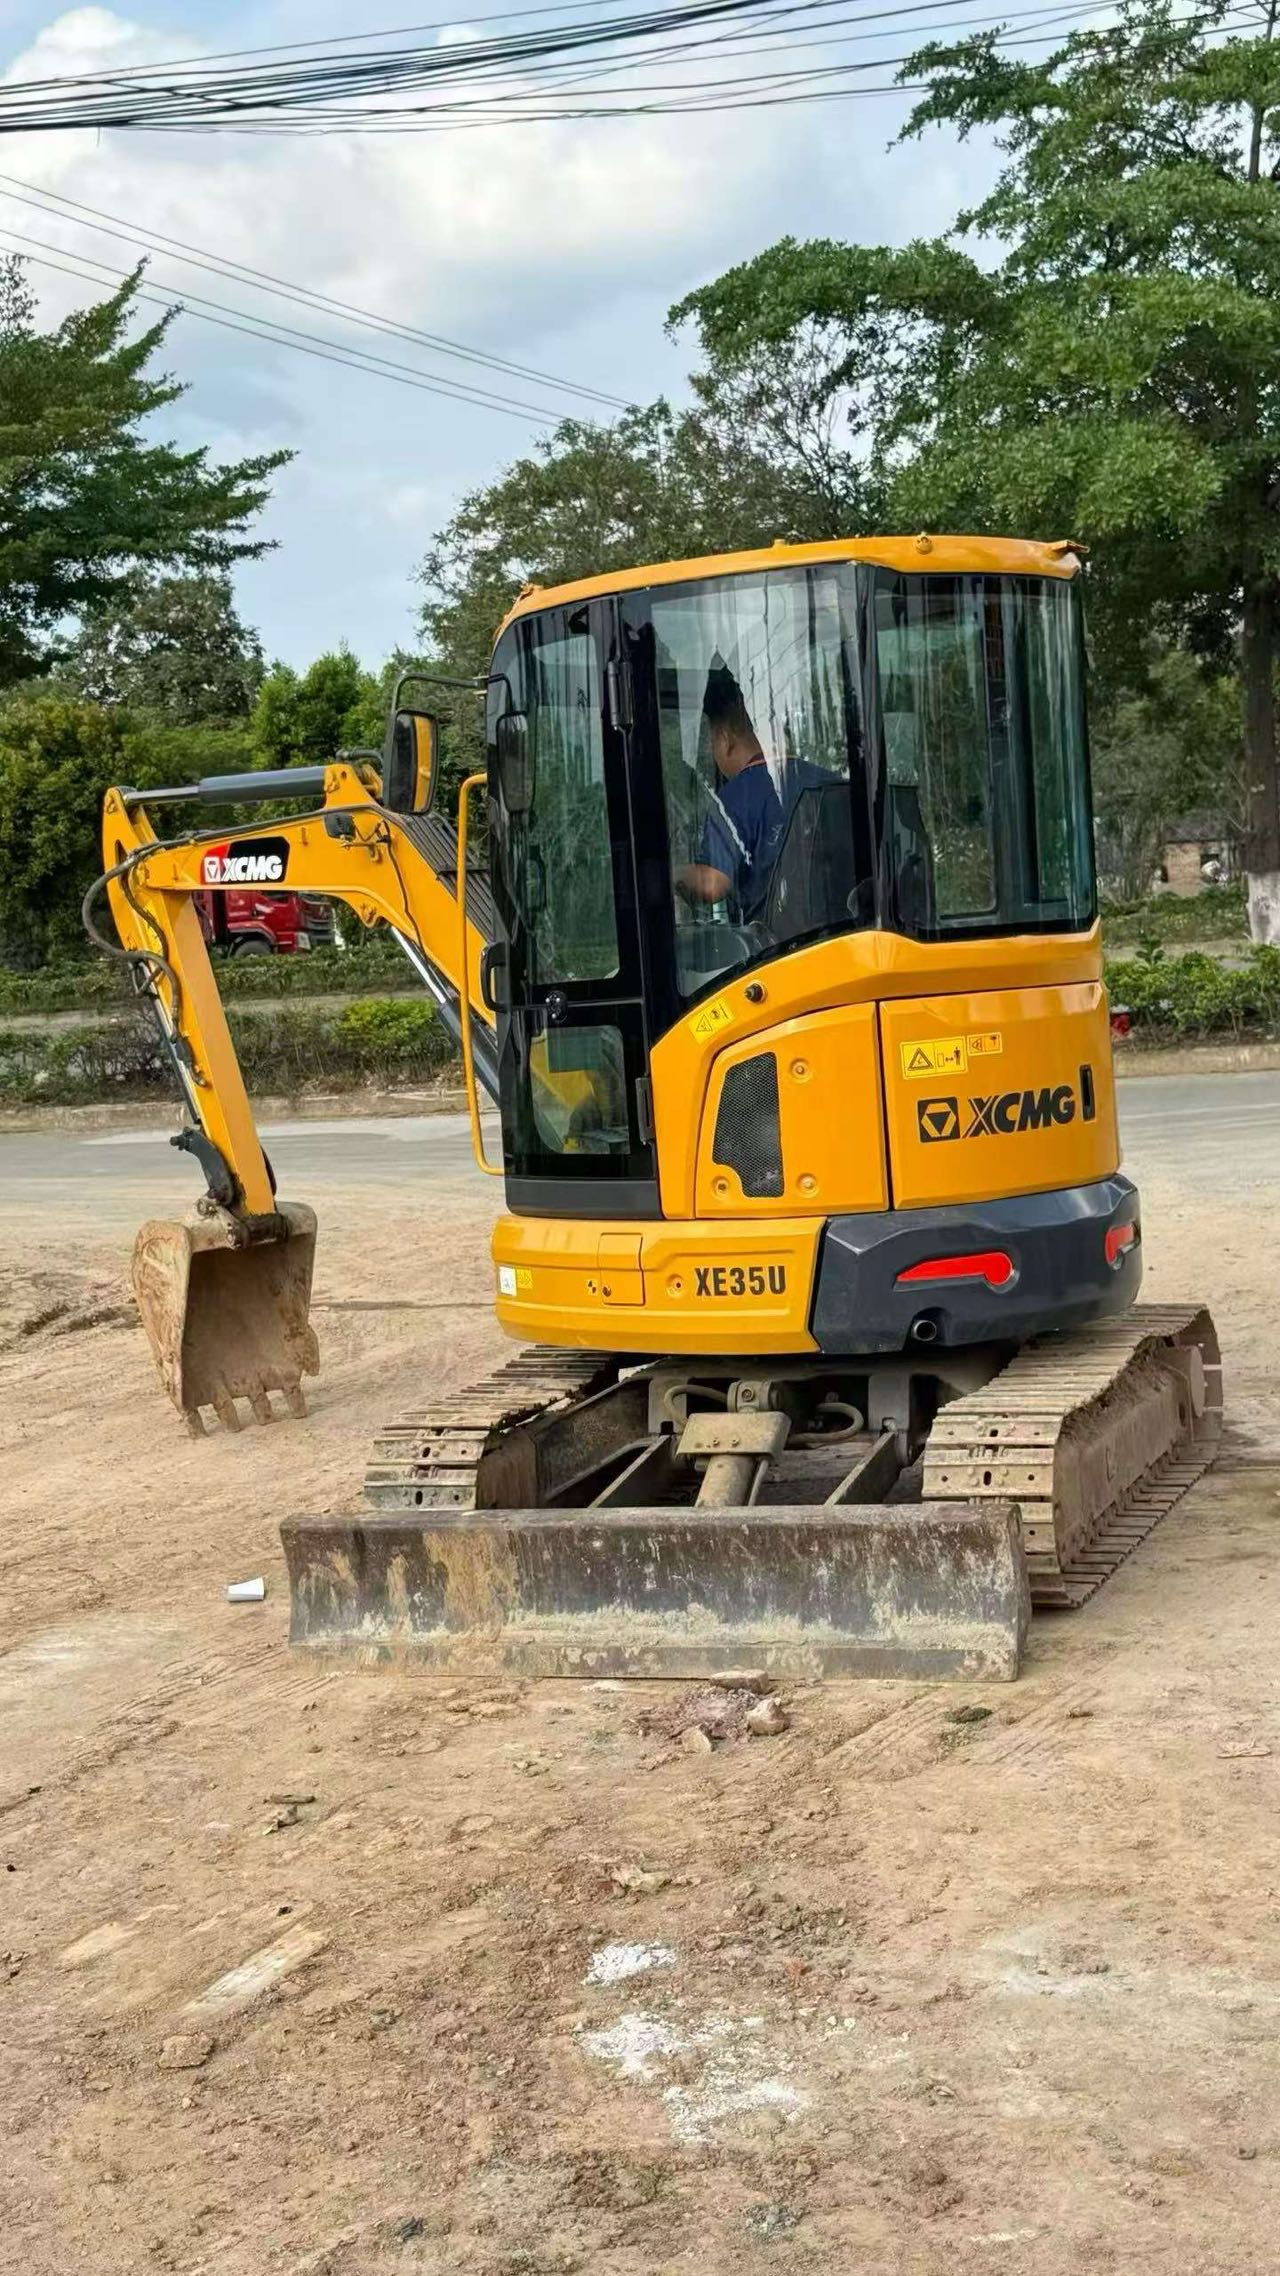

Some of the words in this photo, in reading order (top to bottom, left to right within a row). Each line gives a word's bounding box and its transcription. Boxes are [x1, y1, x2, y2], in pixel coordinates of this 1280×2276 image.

[221, 855, 283, 882] XCMG
[962, 1085, 1075, 1139] XCMG
[694, 1265, 786, 1297] XE35U
